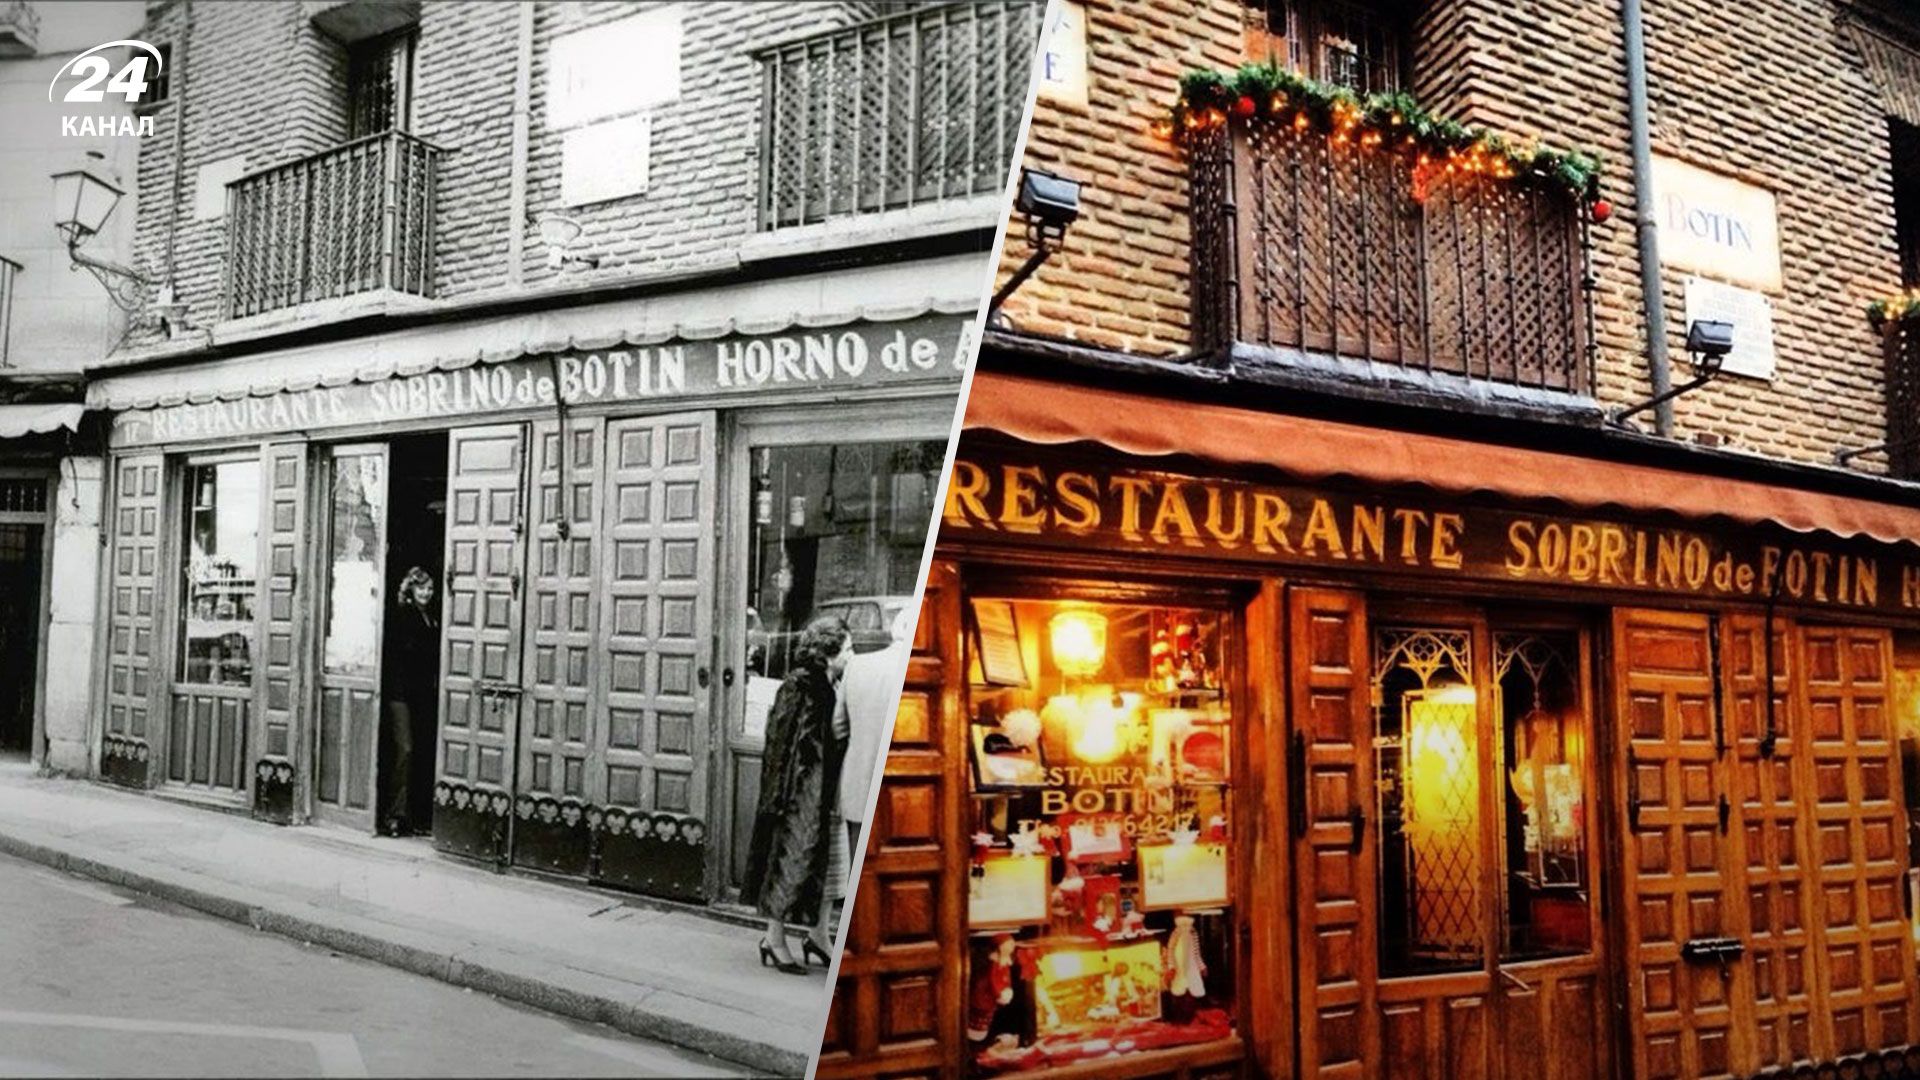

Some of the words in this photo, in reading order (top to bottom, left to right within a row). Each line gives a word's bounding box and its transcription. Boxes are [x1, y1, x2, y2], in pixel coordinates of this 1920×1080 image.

[153, 387, 348, 440] RESTAURANTE
[369, 364, 513, 416] SOBRINO
[516, 369, 556, 404] de
[560, 345, 686, 402] BOTIN
[716, 331, 869, 388] HORNO
[881, 330, 939, 373] de
[944, 461, 1465, 570] RESTAURANTE
[1504, 519, 1710, 591] SOBRINO
[1712, 551, 1756, 595] de
[1041, 787, 1174, 815] BOTIN
